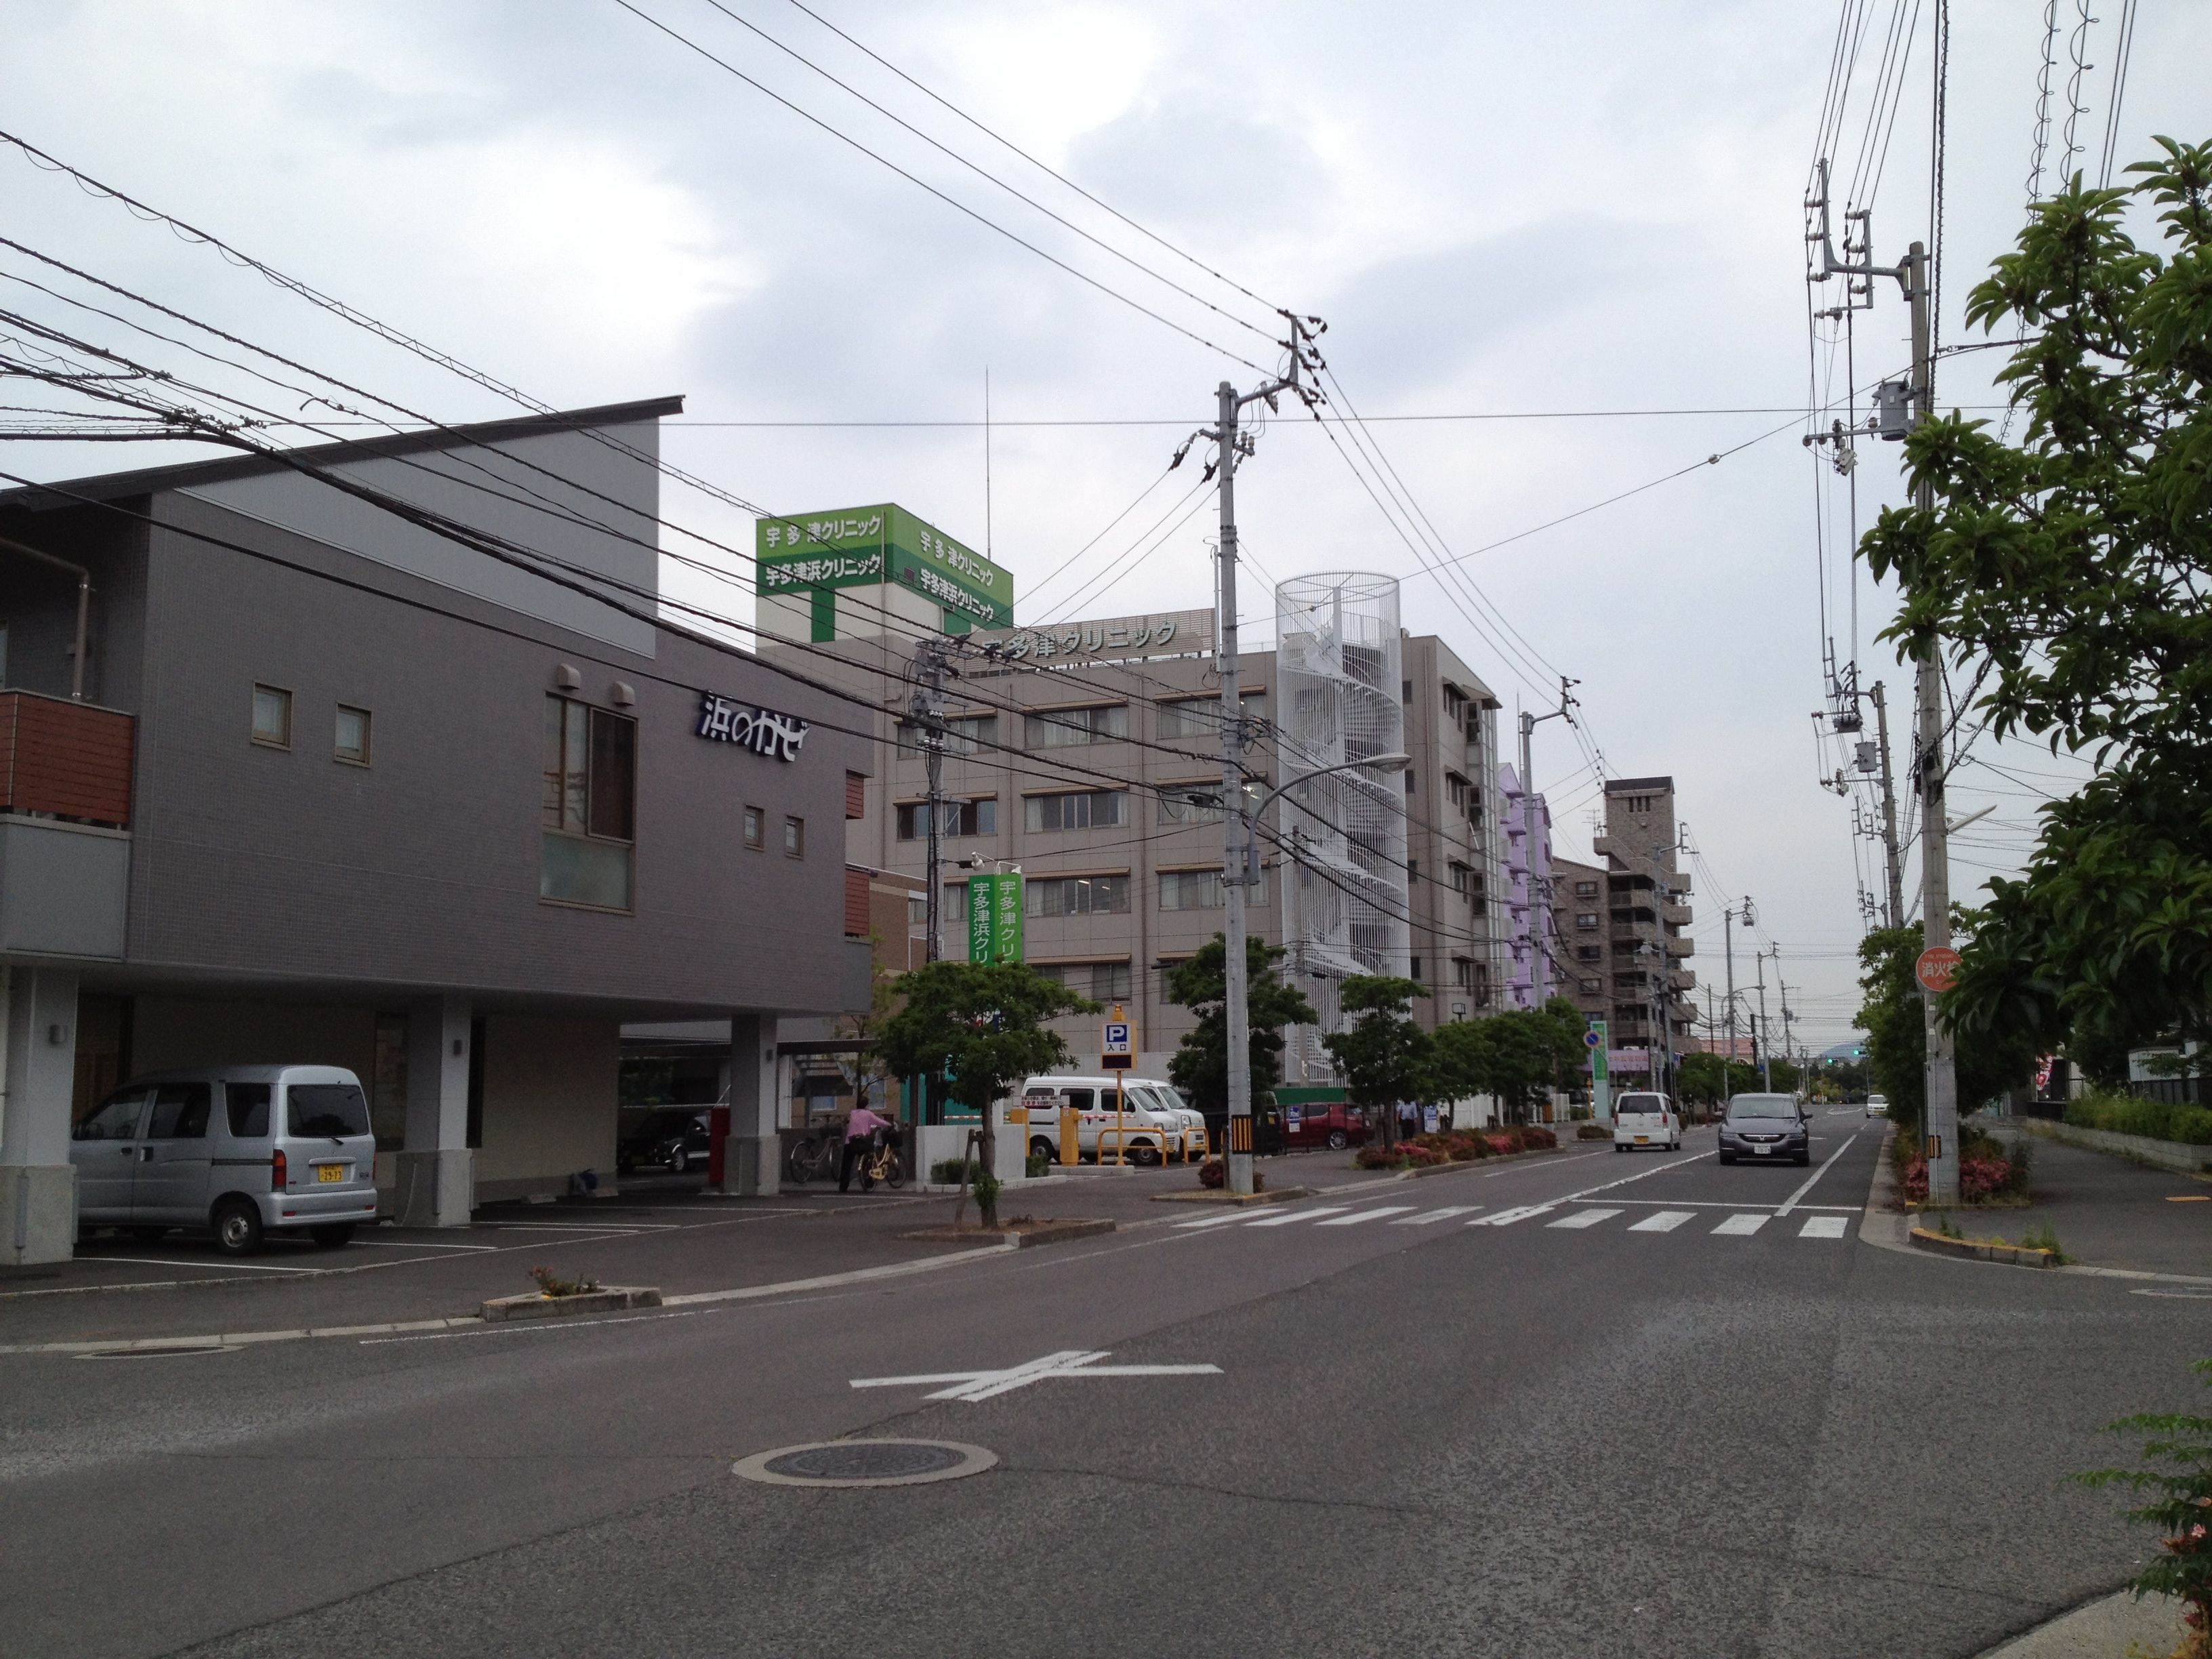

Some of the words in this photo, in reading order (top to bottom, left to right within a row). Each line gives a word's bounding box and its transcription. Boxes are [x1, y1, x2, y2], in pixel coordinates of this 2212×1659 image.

[766, 515, 881, 548] 宇多津クリニック
[766, 554, 881, 587] 宇多津浜クリニック
[920, 531, 994, 587] 宇多津クリニック
[920, 568, 994, 621] 宇多津浜クリニック
[701, 690, 811, 762] 浜のかぜ
[1109, 1025, 1125, 1042] P
